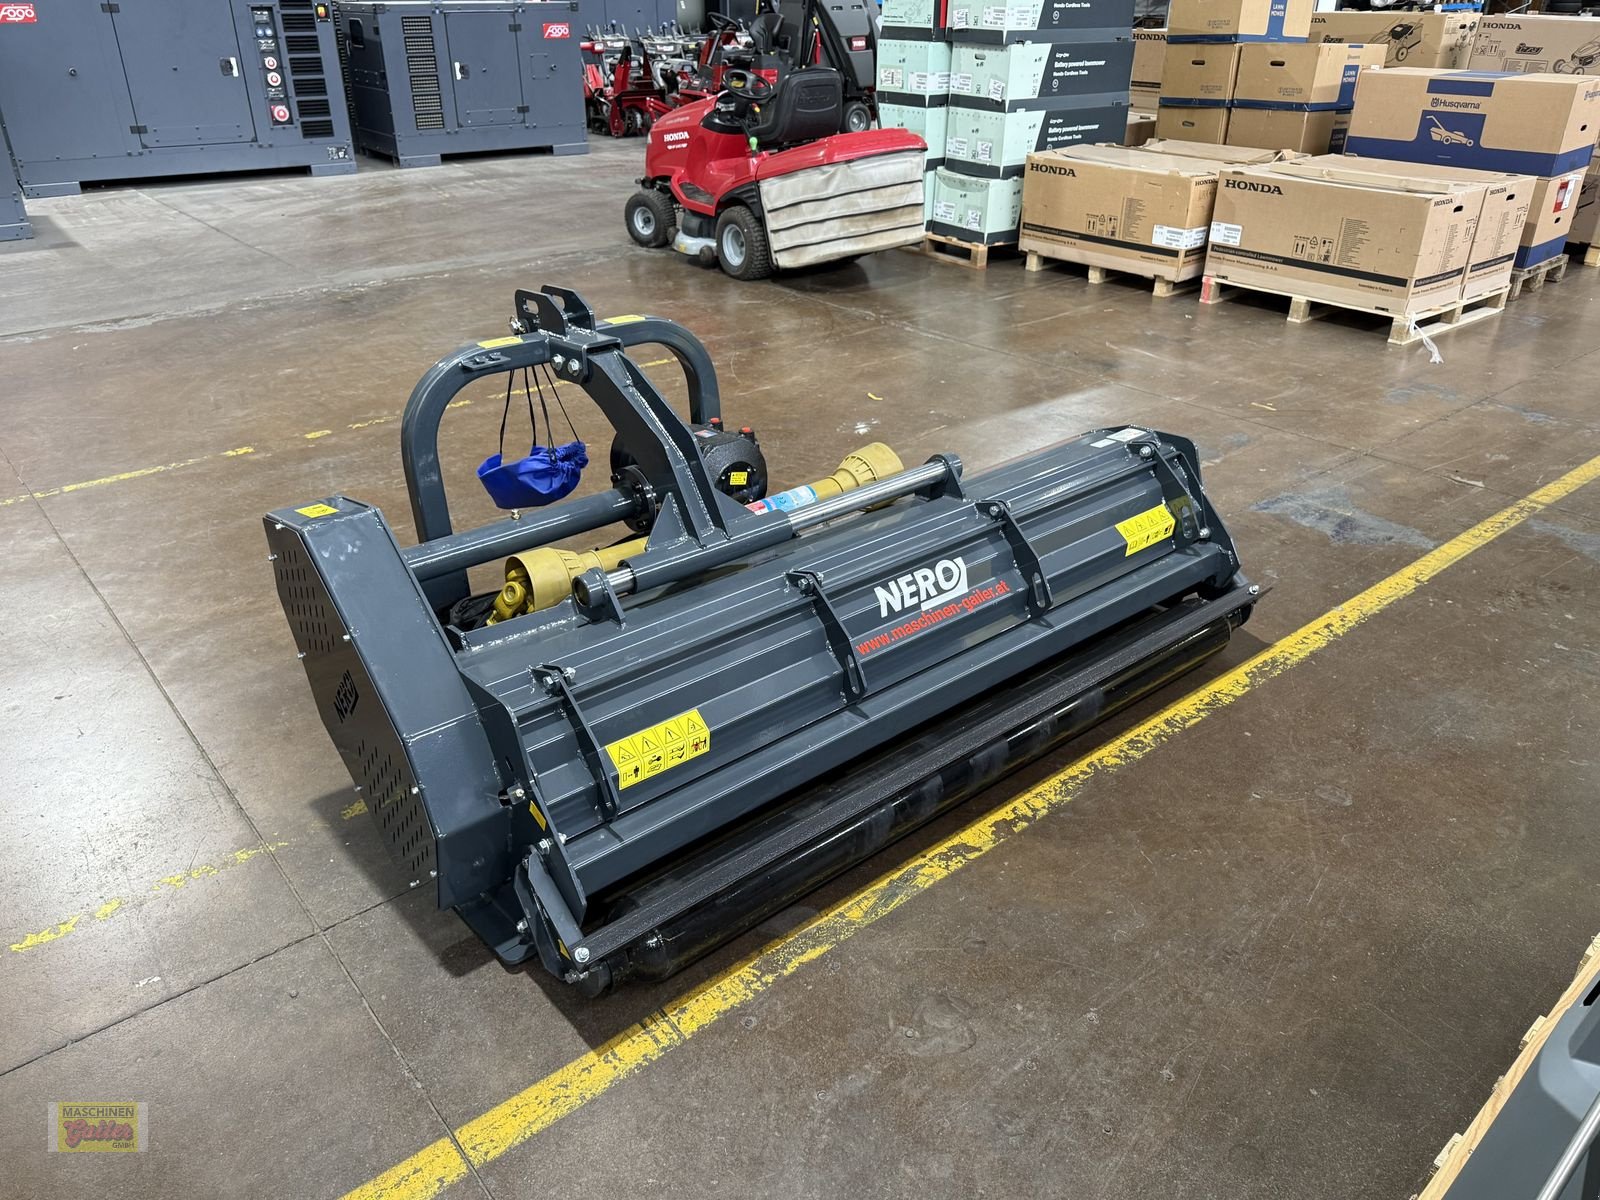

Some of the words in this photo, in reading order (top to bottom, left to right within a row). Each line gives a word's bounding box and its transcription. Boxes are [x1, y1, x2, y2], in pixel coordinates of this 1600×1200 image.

[0, 6, 35, 20] Fogo
[544, 25, 569, 38] Fogo
[1482, 22, 1522, 30] HONDA
[1132, 33, 1167, 41] HONDA
[1438, 99, 1481, 110] Husqvarna
[663, 131, 690, 142] HONDA
[1030, 162, 1077, 178] HONDA
[1194, 178, 1218, 187] HONDA
[1224, 178, 1284, 196] HONDA
[1489, 187, 1507, 196] HONDA
[1433, 198, 1453, 207] HONDA
[874, 557, 966, 618] NERO
[855, 580, 1010, 656] www.maschinen-gailer.at
[333, 670, 356, 724] NERO
